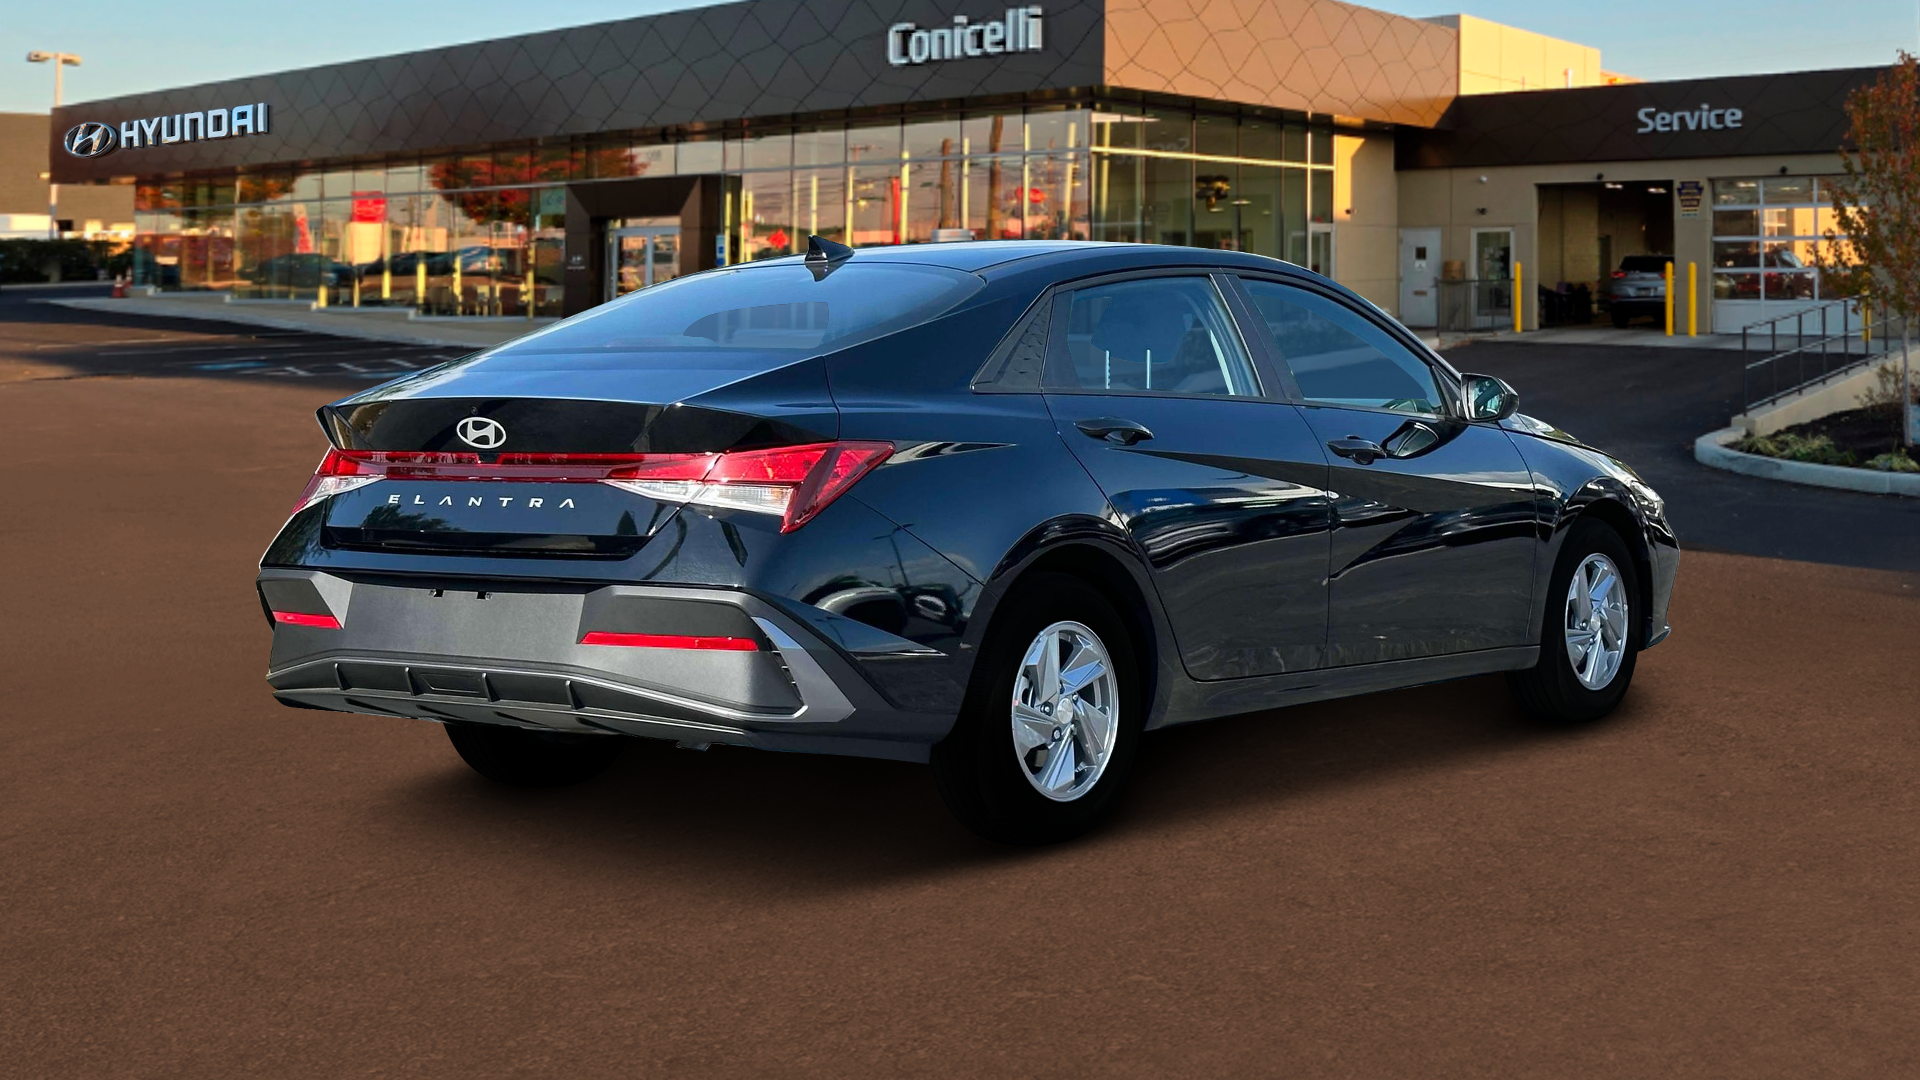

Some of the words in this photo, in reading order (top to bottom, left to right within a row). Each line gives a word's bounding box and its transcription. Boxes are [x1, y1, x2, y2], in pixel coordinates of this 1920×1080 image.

[888, 5, 1043, 66] Conicelli
[121, 103, 268, 149] HYUNDAI
[1637, 103, 1742, 133] Service
[388, 494, 575, 509] ELANTRA
